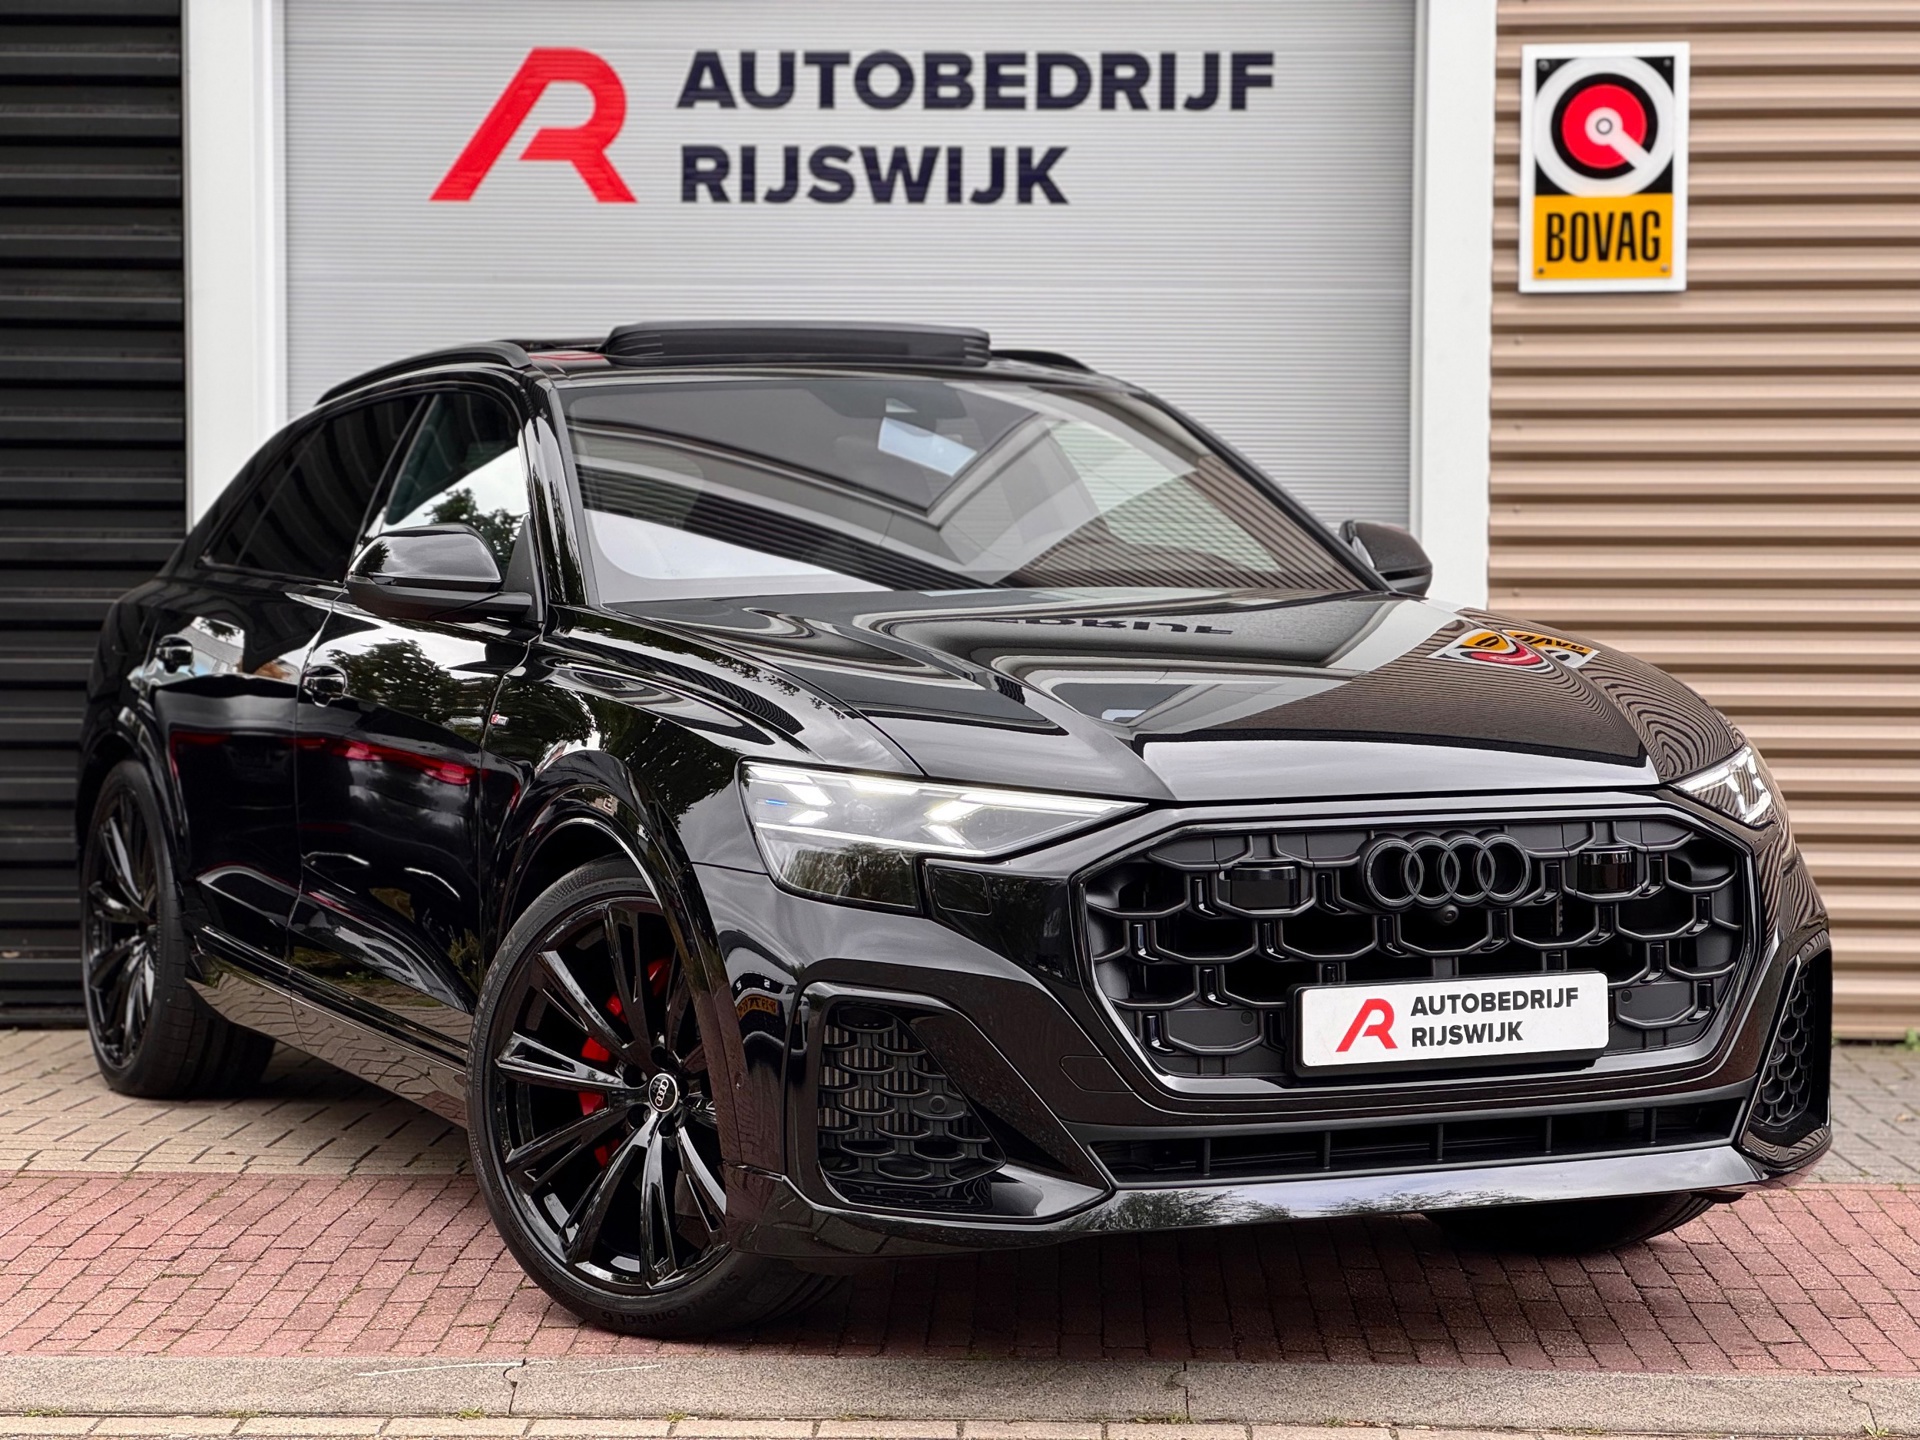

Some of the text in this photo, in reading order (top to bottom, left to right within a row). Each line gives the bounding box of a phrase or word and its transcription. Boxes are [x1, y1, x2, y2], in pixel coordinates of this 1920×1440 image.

[677, 50, 1275, 112] AUTOBEDRIJF
[681, 145, 1069, 205] RIJSWIJK
[1546, 210, 1661, 263] BOVAG
[1410, 987, 1579, 1017] AUTOBEDRIJF
[1411, 1021, 1524, 1048] RIJSWIJK
